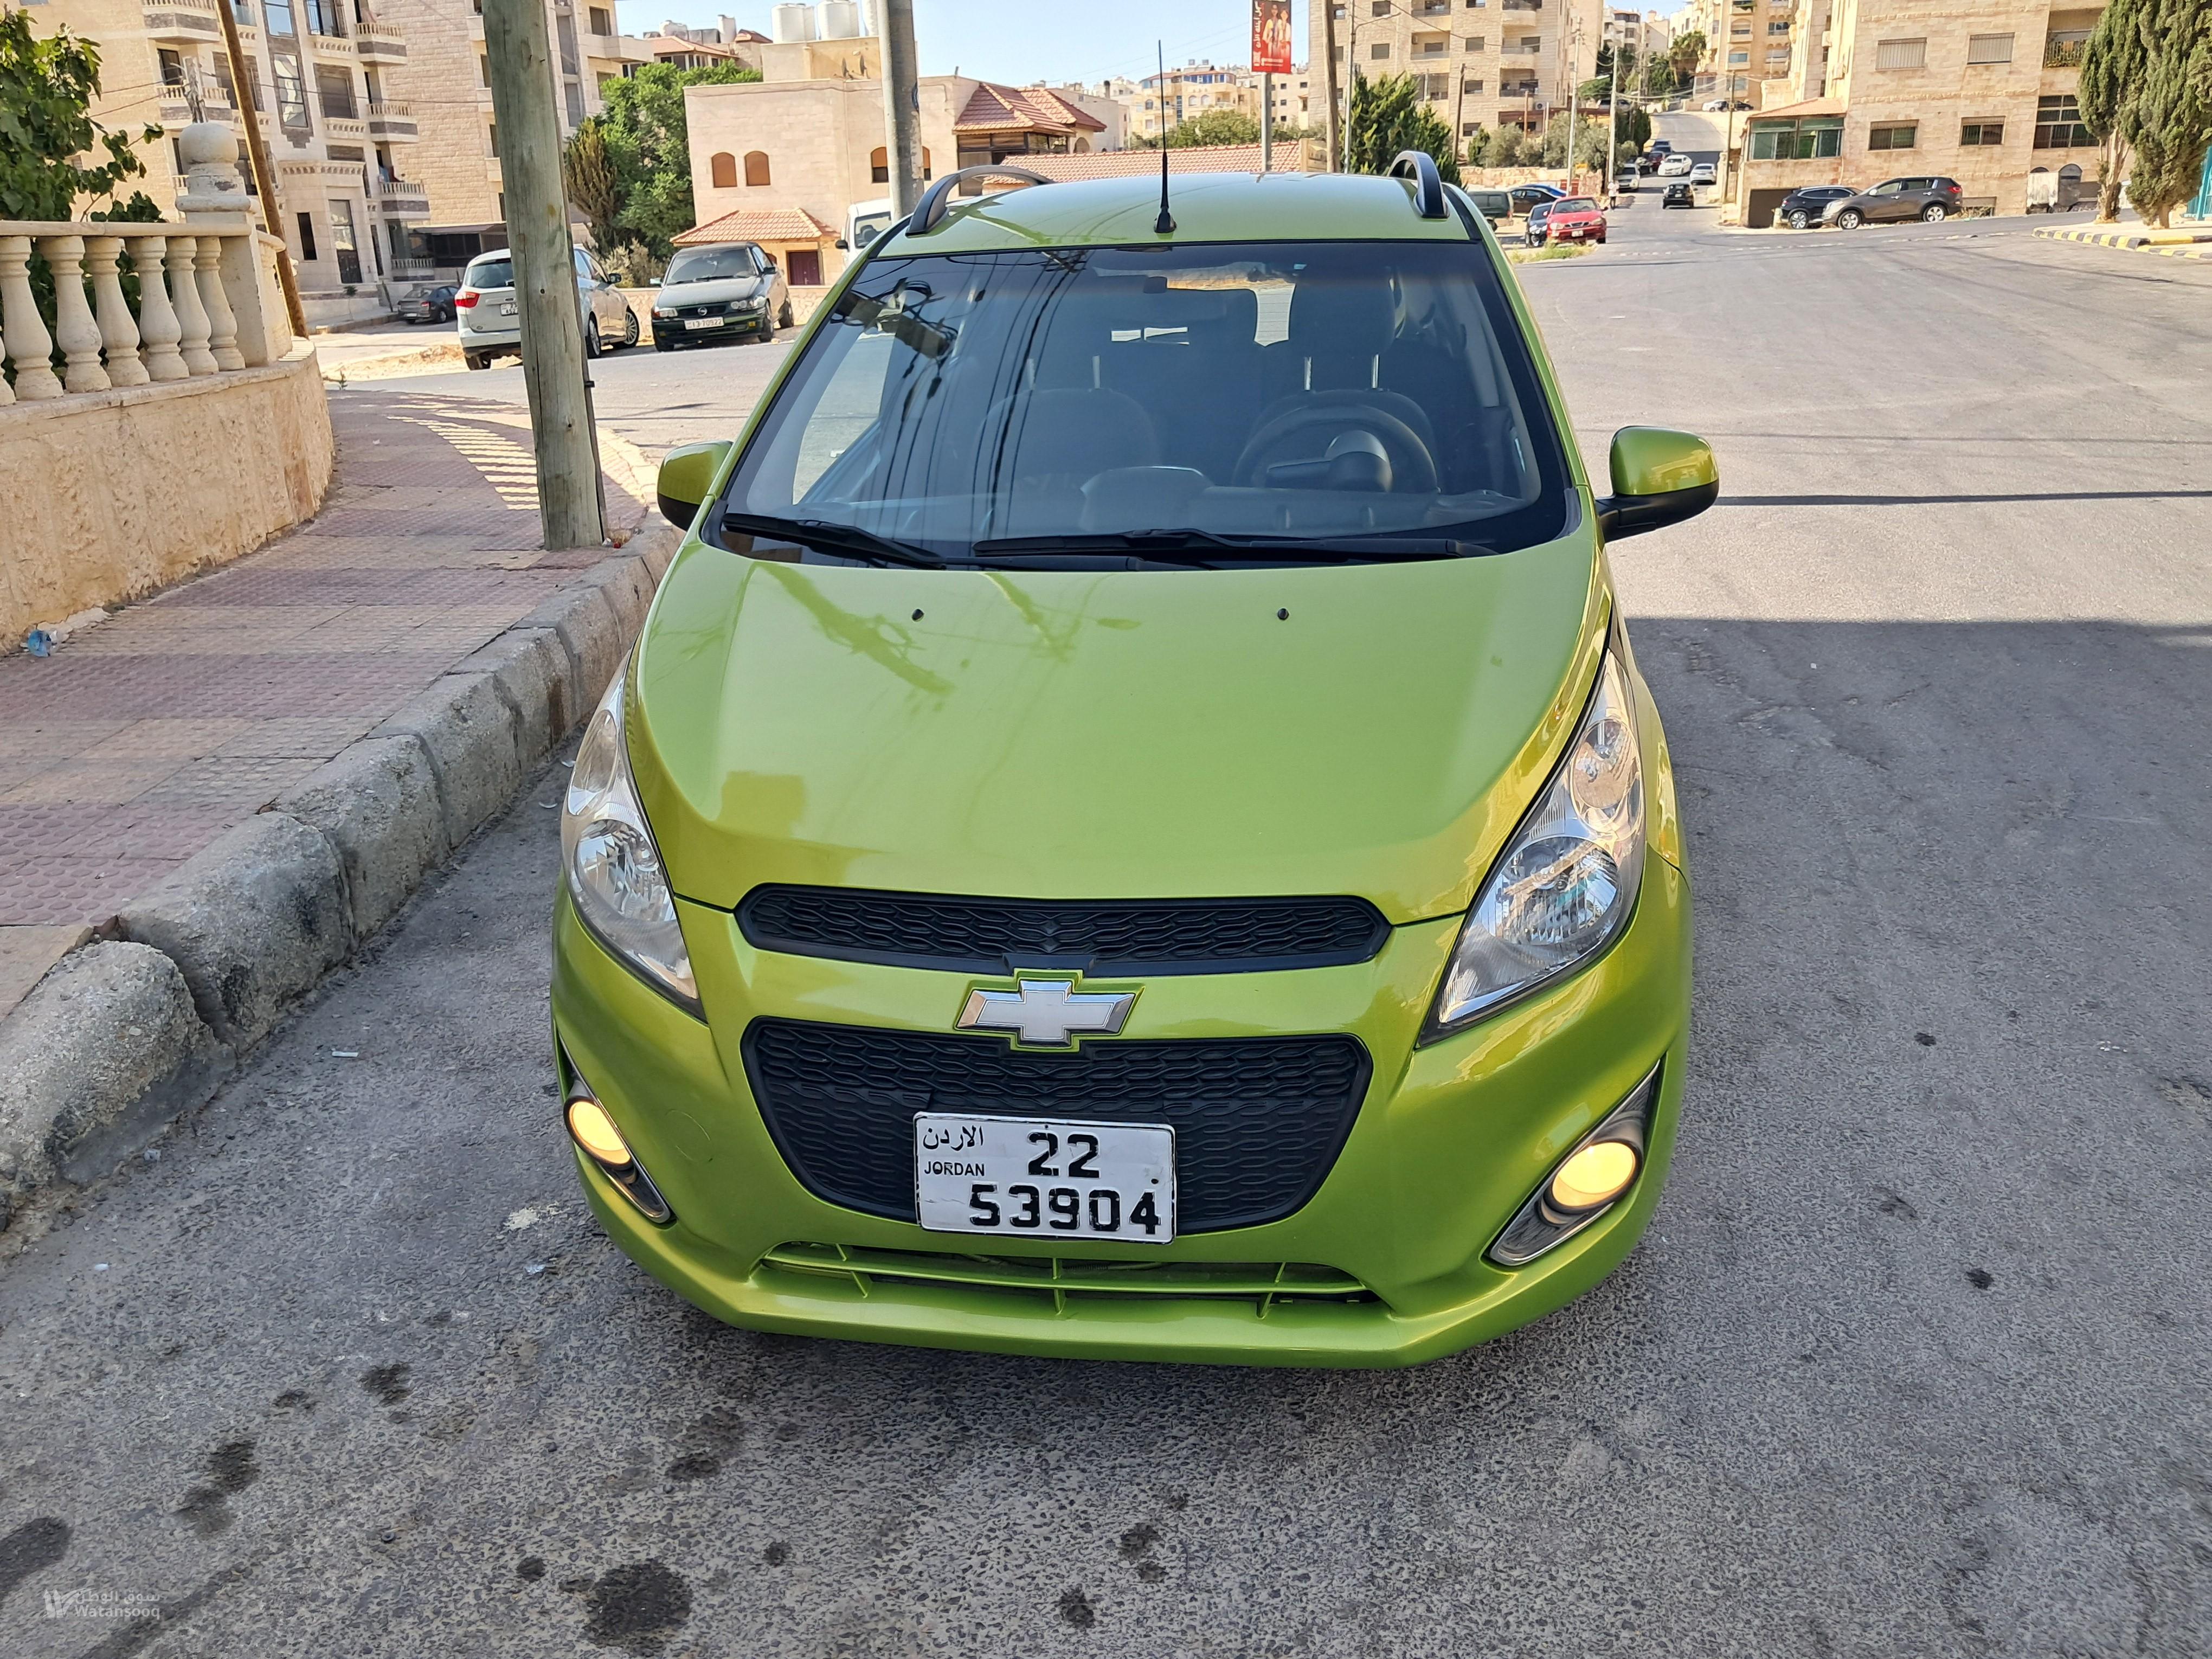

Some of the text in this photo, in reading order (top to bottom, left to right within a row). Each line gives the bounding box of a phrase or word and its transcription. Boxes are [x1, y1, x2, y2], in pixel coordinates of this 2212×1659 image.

[922, 1126, 985, 1150] الاردن
[1026, 1132, 1101, 1178] 22
[924, 1161, 985, 1177] JORDAN
[969, 1183, 1161, 1235] 53904
